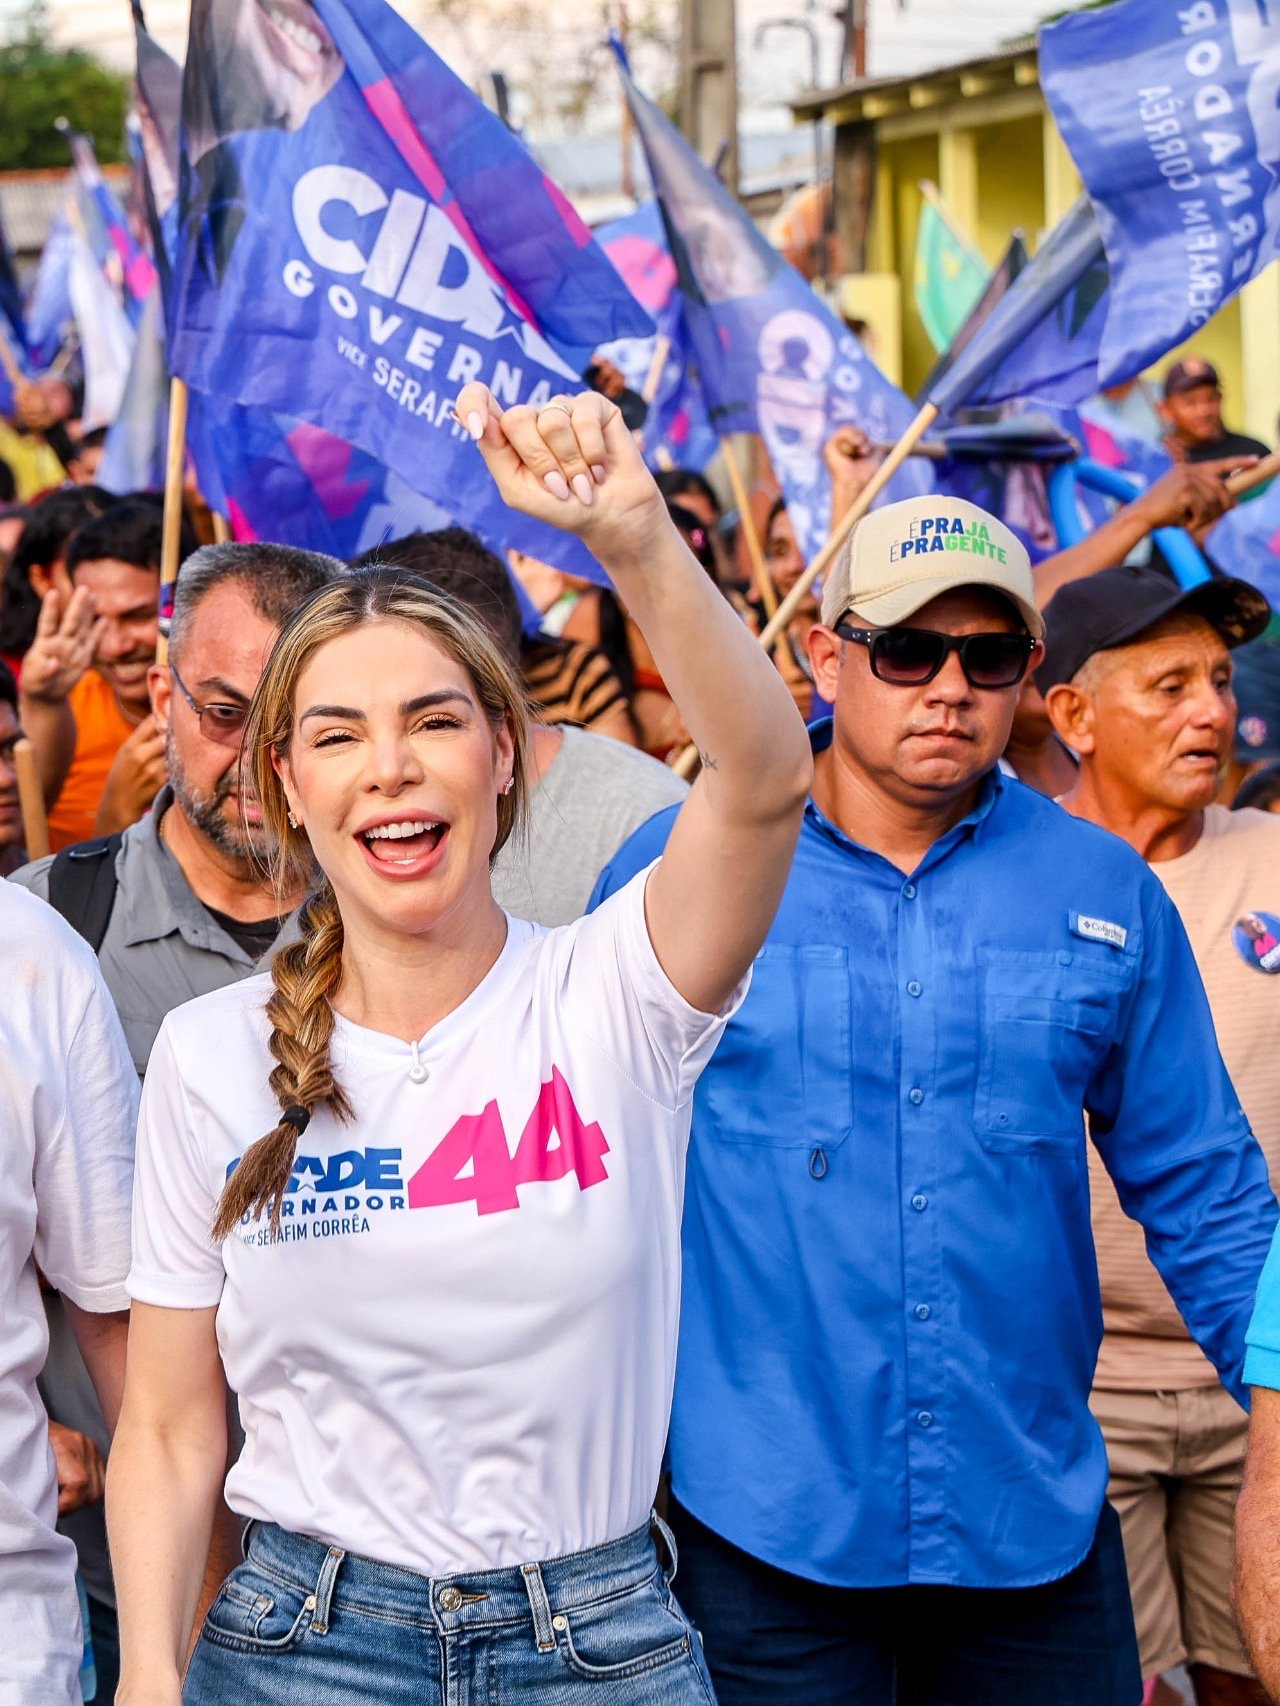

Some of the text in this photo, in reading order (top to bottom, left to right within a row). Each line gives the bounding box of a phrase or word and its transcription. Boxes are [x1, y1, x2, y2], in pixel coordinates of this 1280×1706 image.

[337, 335, 368, 371] VICE
[407, 1063, 611, 1217] 44
[312, 1214, 371, 1238] CORRÊA
